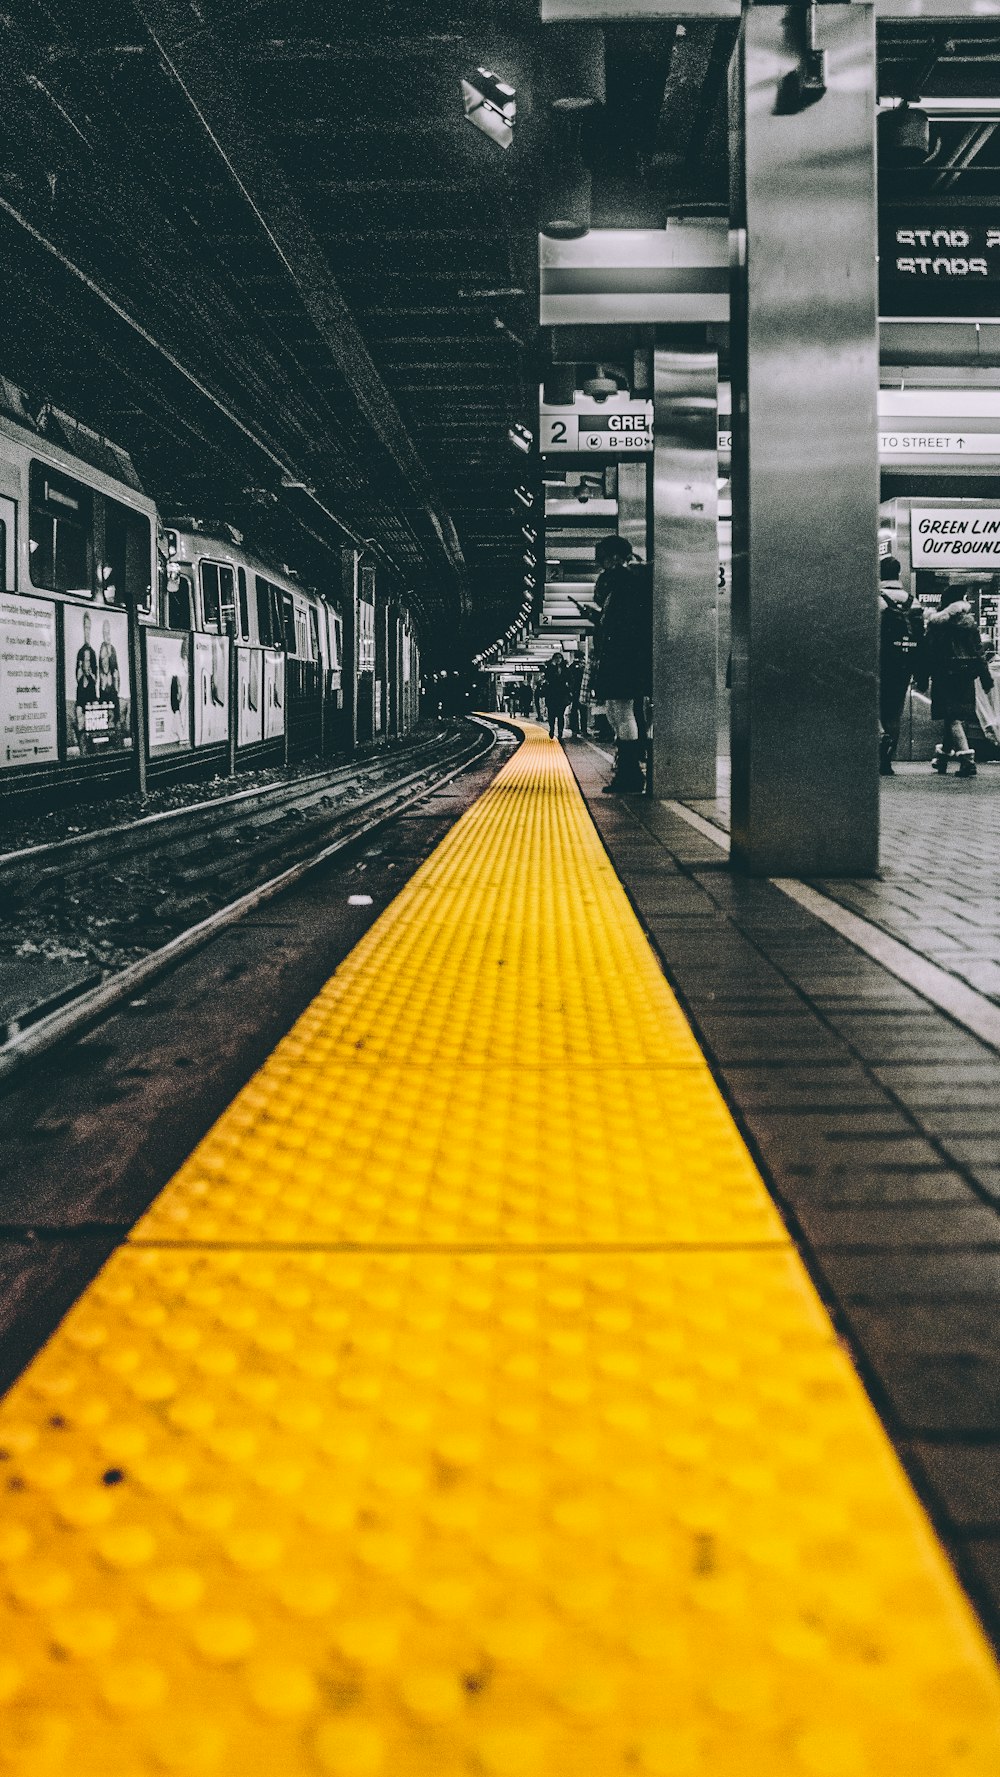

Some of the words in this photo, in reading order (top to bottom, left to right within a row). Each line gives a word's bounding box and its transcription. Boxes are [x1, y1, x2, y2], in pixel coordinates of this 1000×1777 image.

[608, 415, 645, 431] GRE
[550, 421, 567, 443] 2
[881, 437, 898, 448] TO
[902, 437, 951, 448] STREET
[918, 518, 969, 534] GREEN
[971, 520, 1000, 534] LIN
[922, 538, 1000, 554] OUTBOUND
[542, 616, 549, 625] 2
